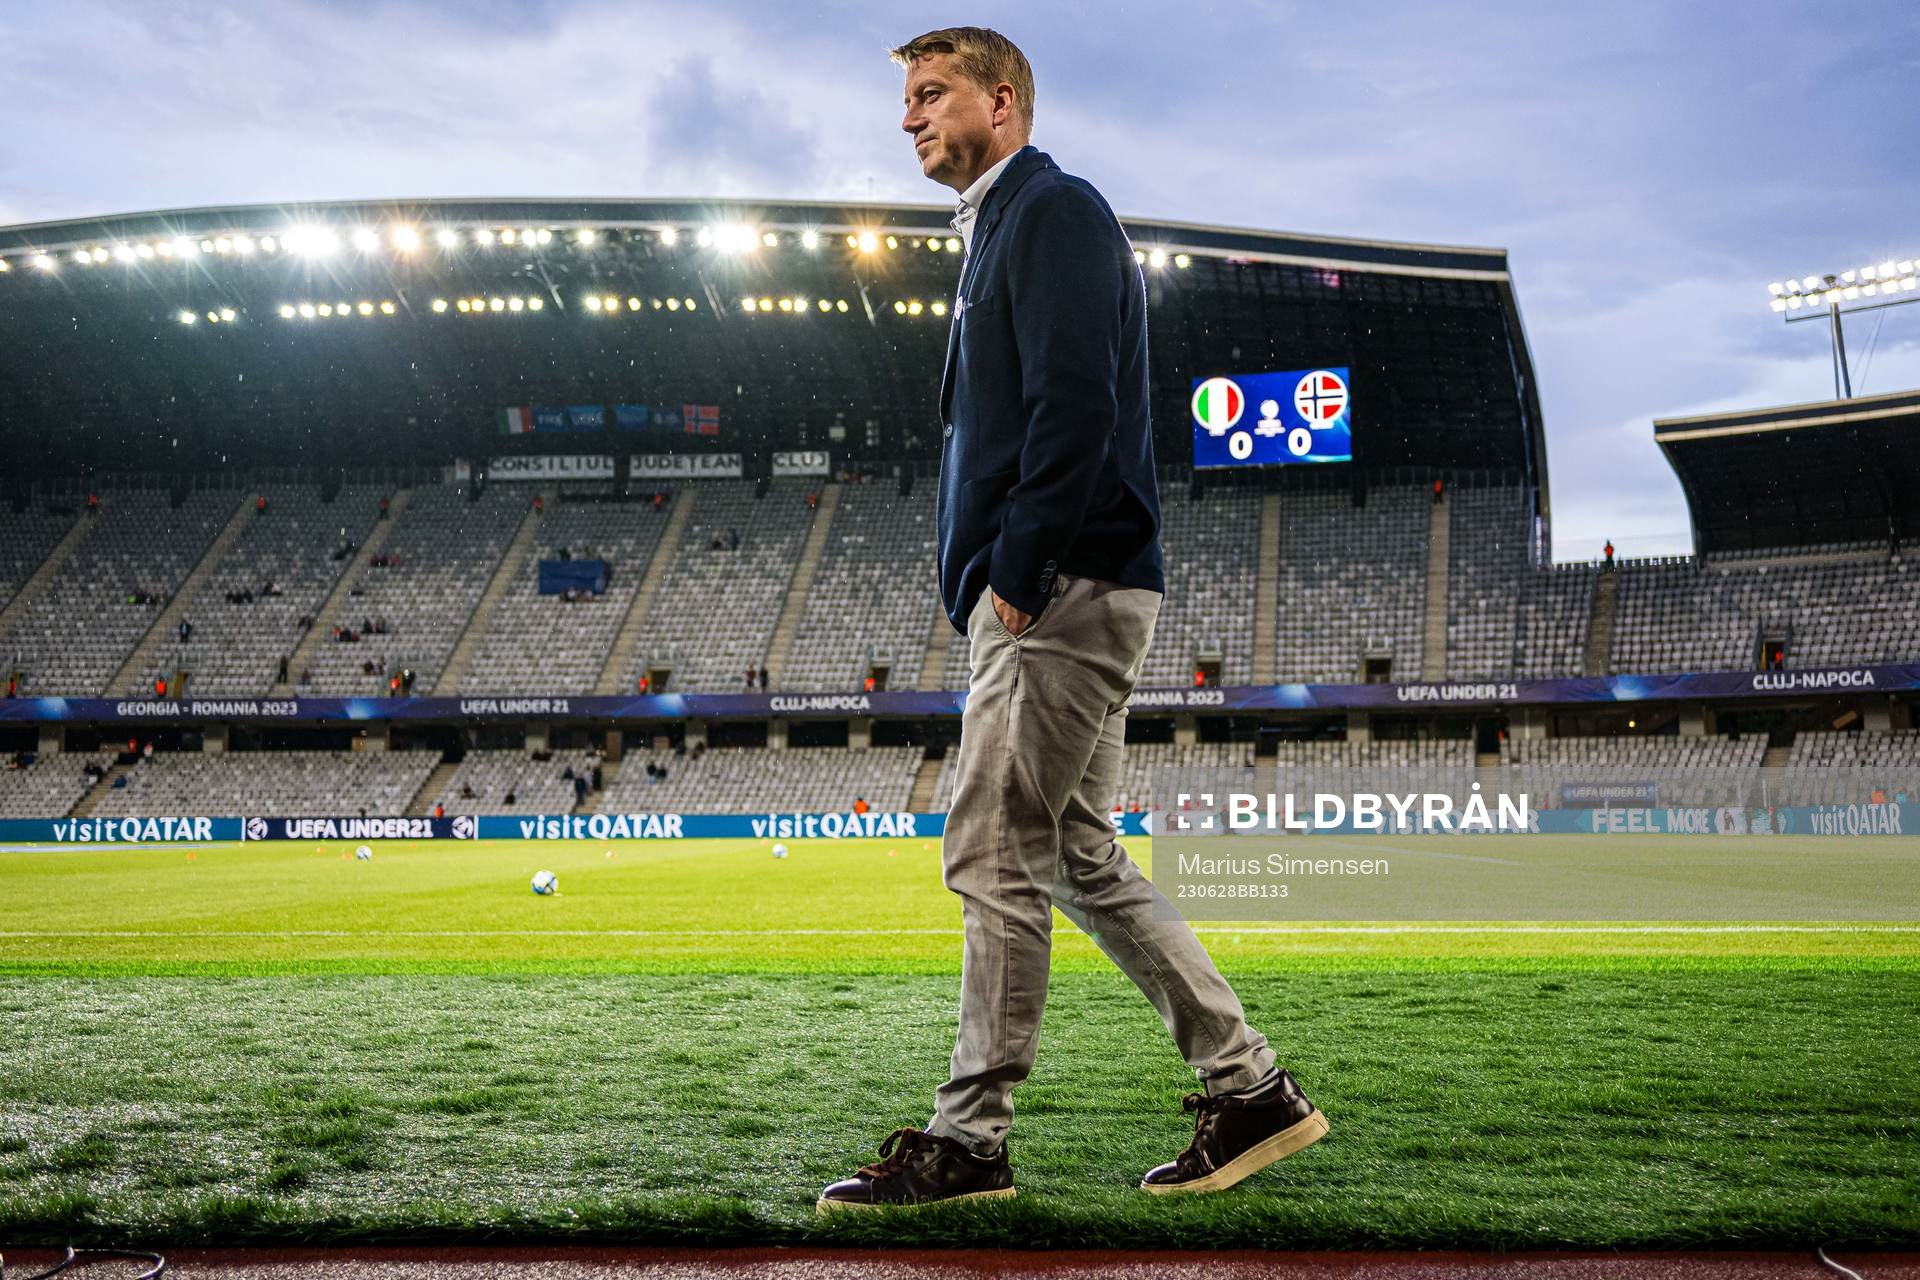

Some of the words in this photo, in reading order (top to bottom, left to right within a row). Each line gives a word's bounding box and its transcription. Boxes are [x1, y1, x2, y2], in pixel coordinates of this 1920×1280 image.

[1229, 431, 1253, 460] 0
[1288, 427, 1312, 456] 0
[774, 452, 827, 468] CLUJ
[1752, 670, 1875, 690] CLUJ-NAPOCA
[1187, 690, 1224, 705] 2023
[1397, 686, 1439, 701] UEFA
[1441, 684, 1497, 700] UNDER
[1499, 684, 1518, 699] 21
[117, 702, 180, 716] GEORGIA
[192, 702, 258, 716] ROMANIA
[262, 702, 298, 716] 2023
[461, 699, 499, 714] UEFA
[500, 699, 551, 714] UNDER
[552, 699, 569, 713] 21
[770, 696, 870, 711] CLUJ-NAPOCA
[53, 817, 213, 843] visitQATAR
[285, 819, 338, 839] UEFA
[340, 818, 434, 838] UNDER21
[519, 814, 684, 840] visitQATAR
[751, 812, 917, 838] visitQATAR
[1592, 808, 1661, 833] FEEL
[1667, 808, 1710, 834] MORE
[1811, 803, 1902, 837] visitQATAR
